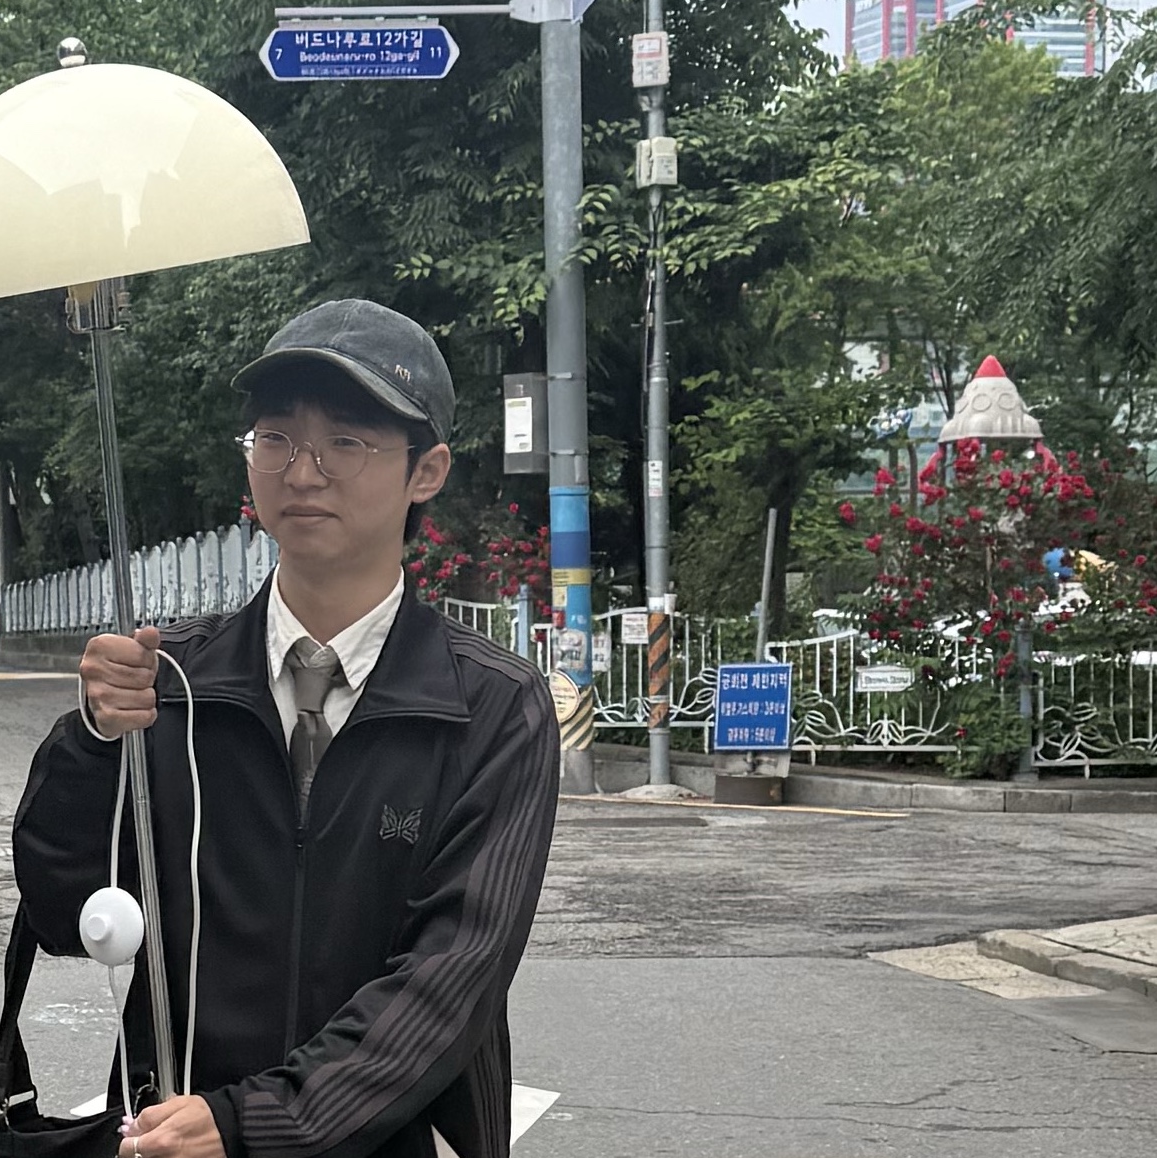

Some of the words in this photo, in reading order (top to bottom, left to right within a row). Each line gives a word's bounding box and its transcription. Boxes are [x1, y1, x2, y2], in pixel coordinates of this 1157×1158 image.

[295, 29, 423, 49] 버드나루로12가길
[275, 48, 283, 61] 7
[430, 46, 442, 59] 11
